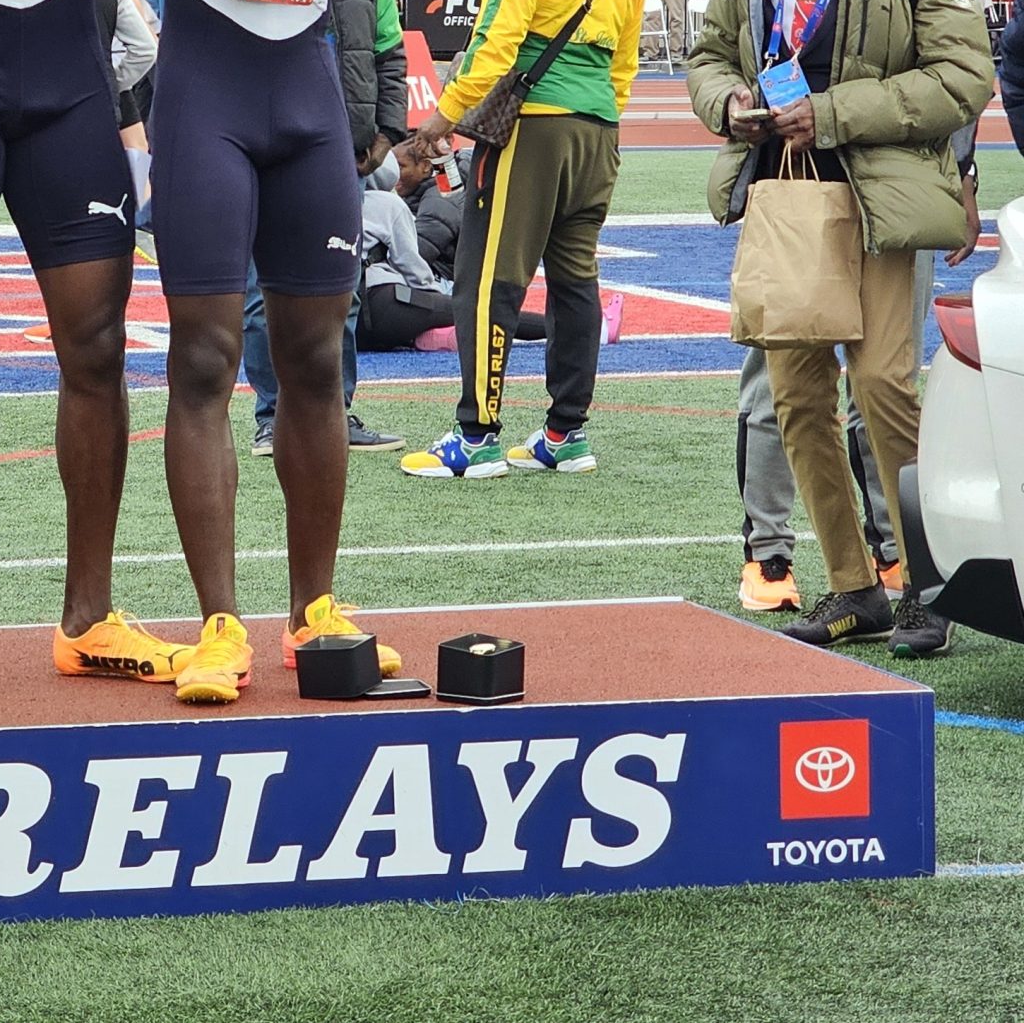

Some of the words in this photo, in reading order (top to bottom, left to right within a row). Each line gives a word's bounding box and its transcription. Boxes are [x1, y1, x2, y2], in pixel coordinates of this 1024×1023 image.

[491, 324, 506, 371] RL67
[826, 613, 857, 638] JAMAICA
[73, 647, 155, 676] NITRO
[765, 837, 885, 868] TOYOTA
